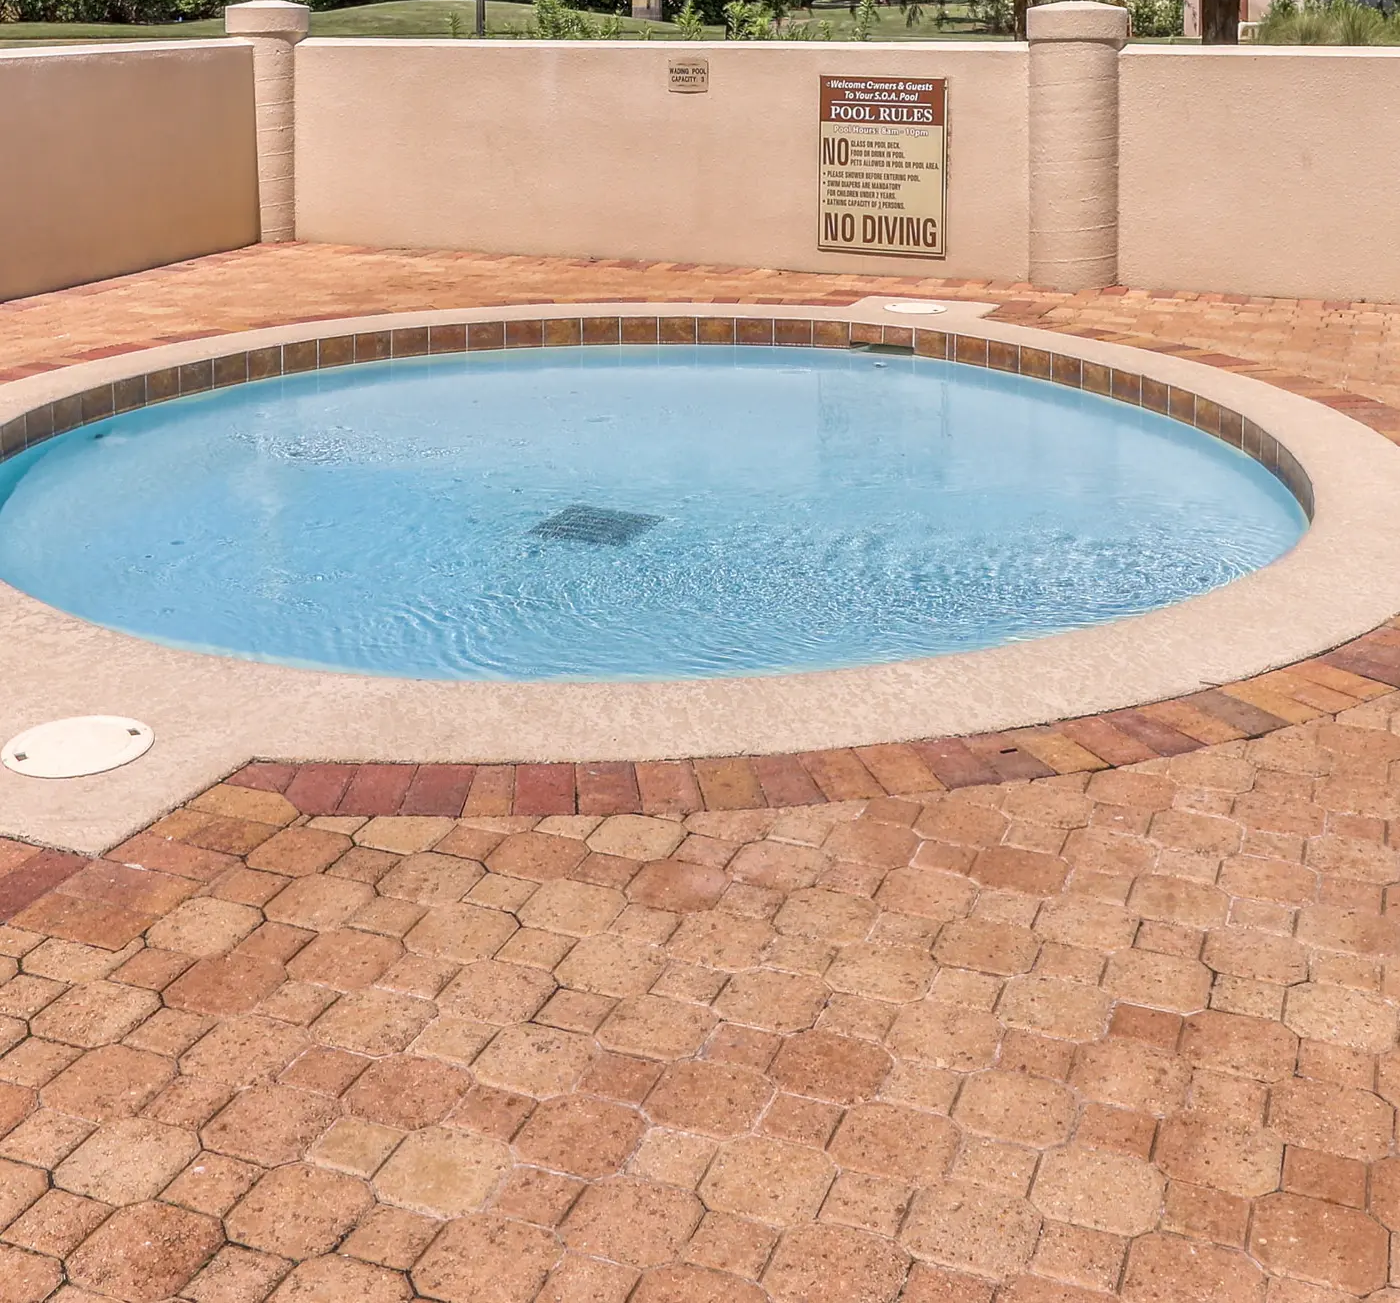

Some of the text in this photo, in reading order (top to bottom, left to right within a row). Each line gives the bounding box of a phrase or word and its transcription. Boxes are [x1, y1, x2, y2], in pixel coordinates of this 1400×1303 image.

[830, 80, 933, 91] Welcome Owners & Guests
[844, 90, 918, 102] To Your S.O.A. Pool
[830, 105, 934, 122] POOL RULES
[834, 124, 852, 134] Pool
[882, 126, 900, 136] 8am
[906, 128, 928, 138] 10pm
[850, 140, 866, 148] GLASS
[874, 141, 887, 149] POOL
[822, 137, 850, 166] NO
[850, 159, 862, 167] PETS
[863, 160, 885, 168] ALLOWED
[892, 161, 904, 169] POOL
[866, 172, 883, 180] BEFORE
[884, 173, 906, 181] ENTERING
[842, 181, 860, 189] DIAPERS
[872, 182, 901, 190] MANDATORY
[837, 190, 858, 198] CHILDREN
[826, 198, 847, 206] BATHING
[848, 200, 870, 208] CAPACITY
[824, 212, 937, 248] NO DIVING
